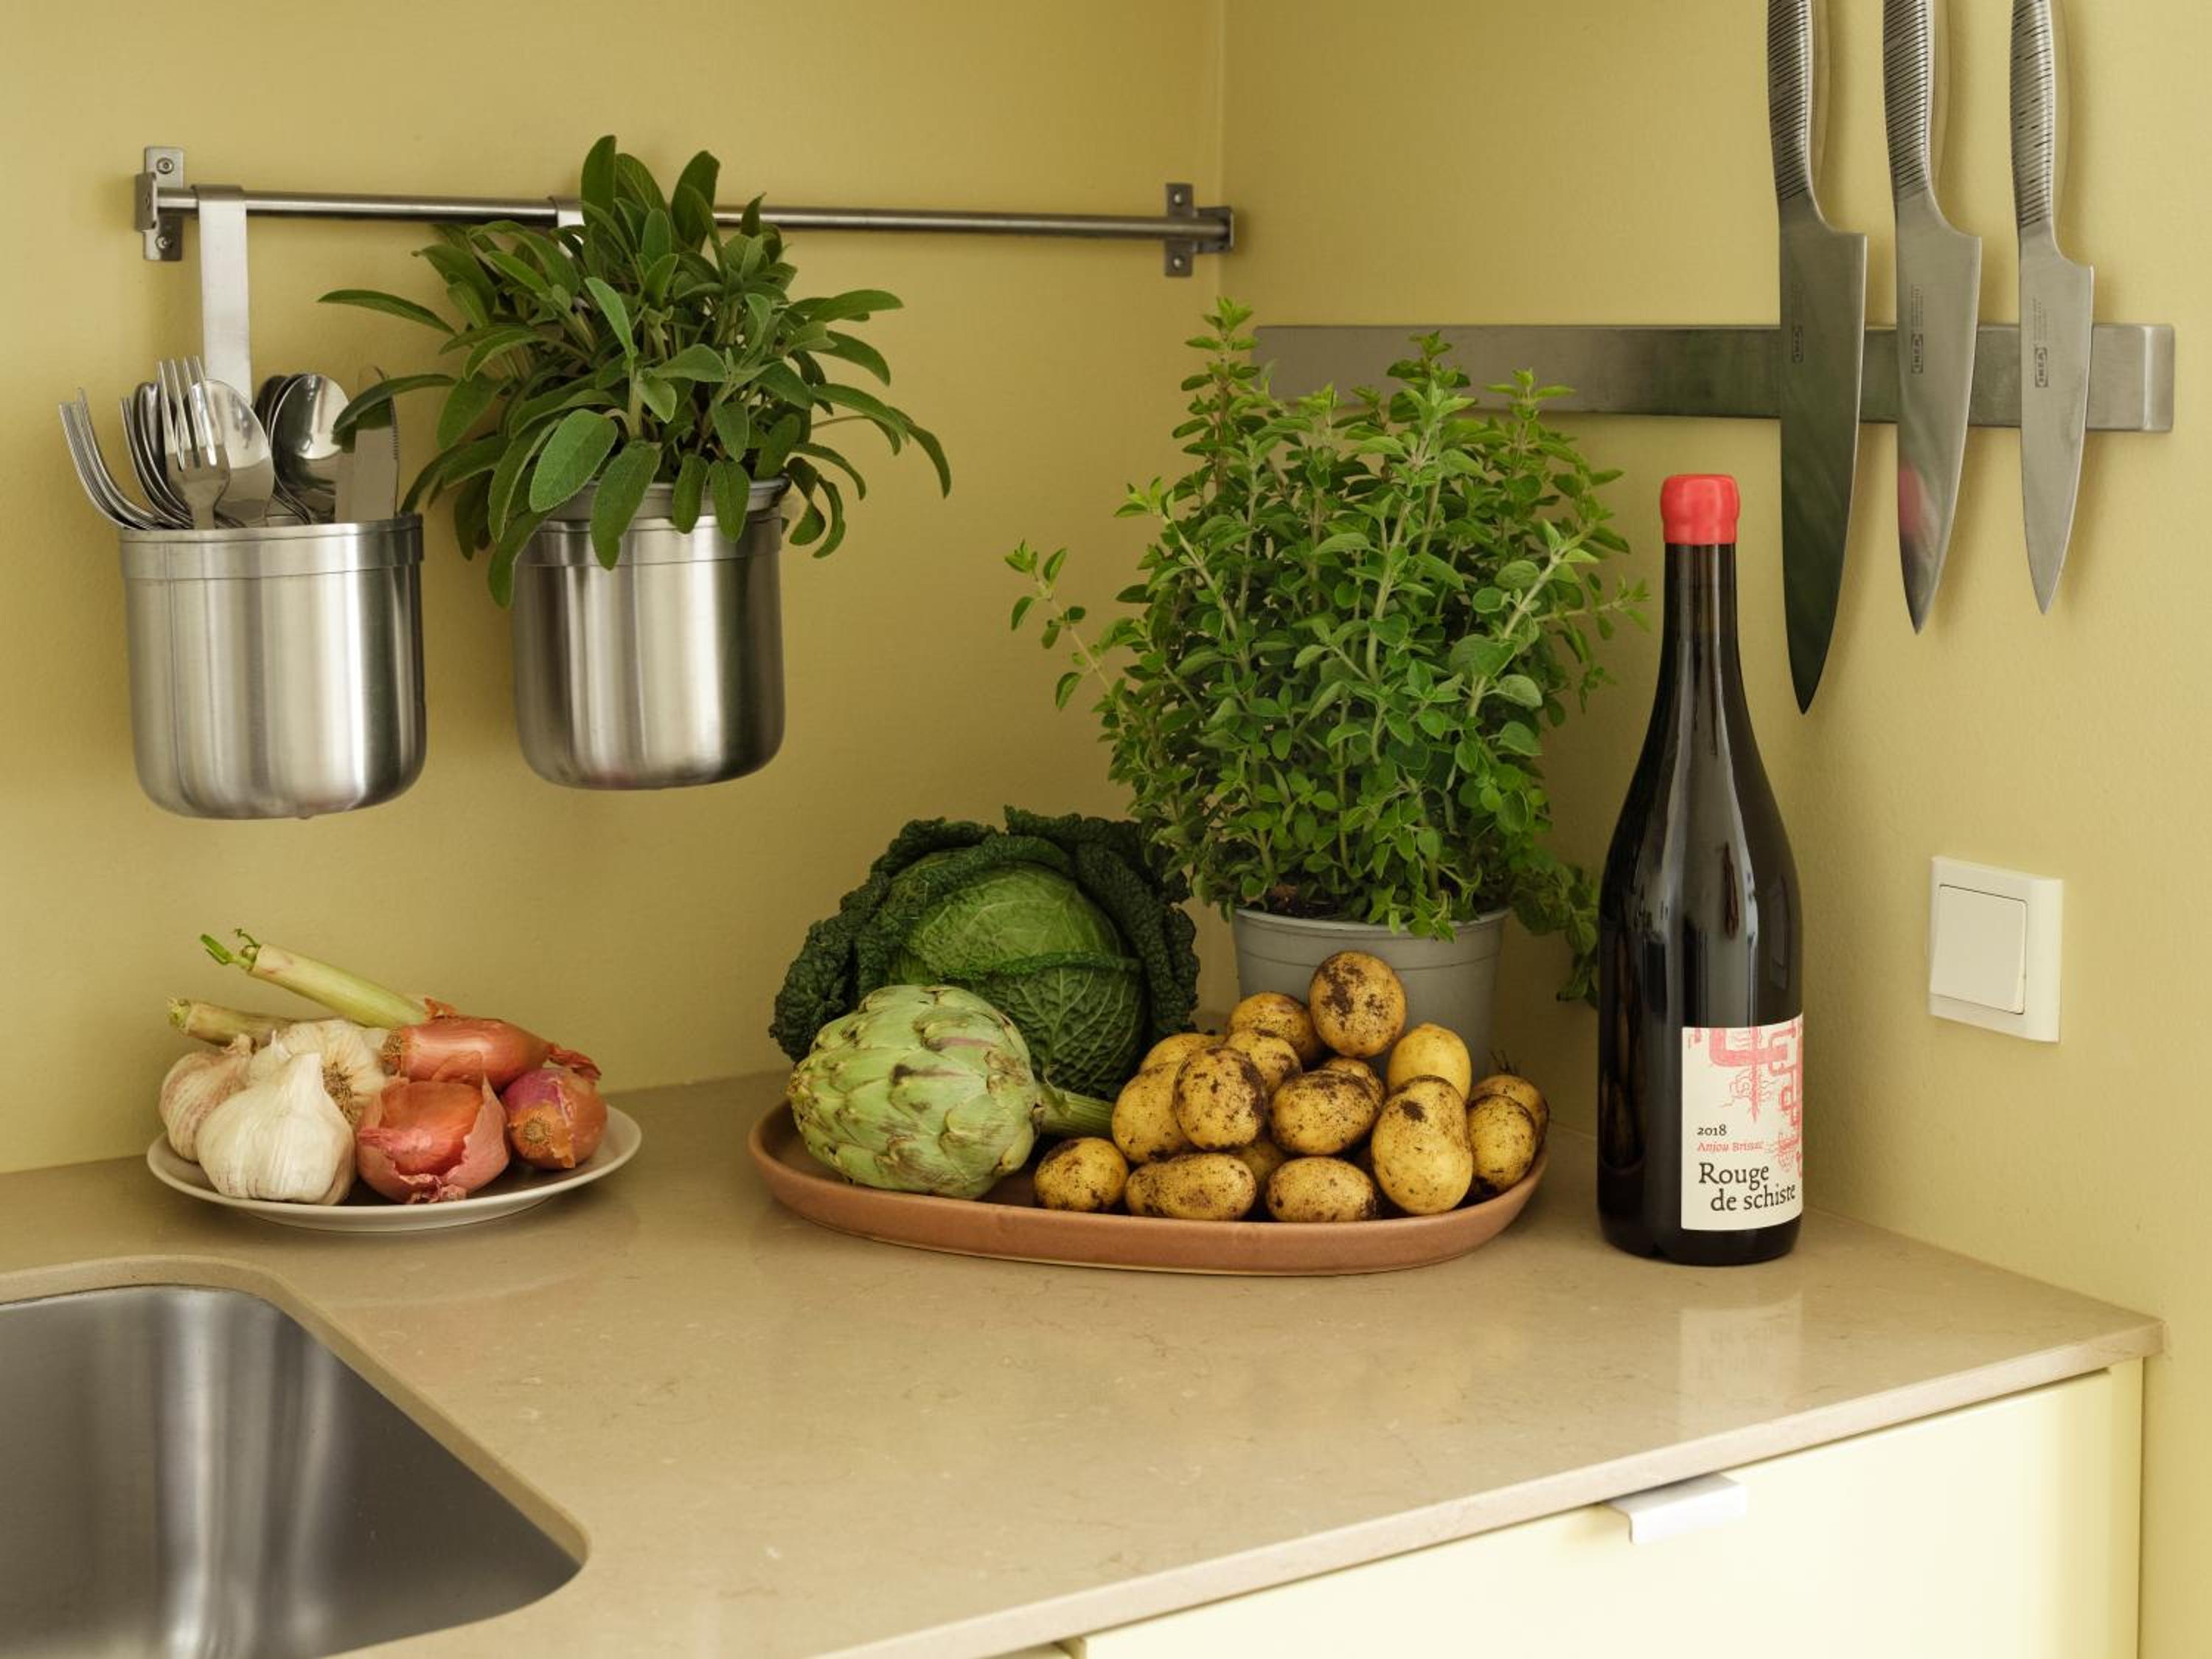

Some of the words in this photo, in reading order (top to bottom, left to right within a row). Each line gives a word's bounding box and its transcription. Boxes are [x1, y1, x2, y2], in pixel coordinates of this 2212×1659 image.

[1697, 1124, 1727, 1136] 2018
[1697, 1141, 1729, 1152] Anjou
[1698, 1162, 1770, 1192] Rouge
[1711, 1188, 1737, 1211] de
[1743, 1183, 1796, 1210] schiste
